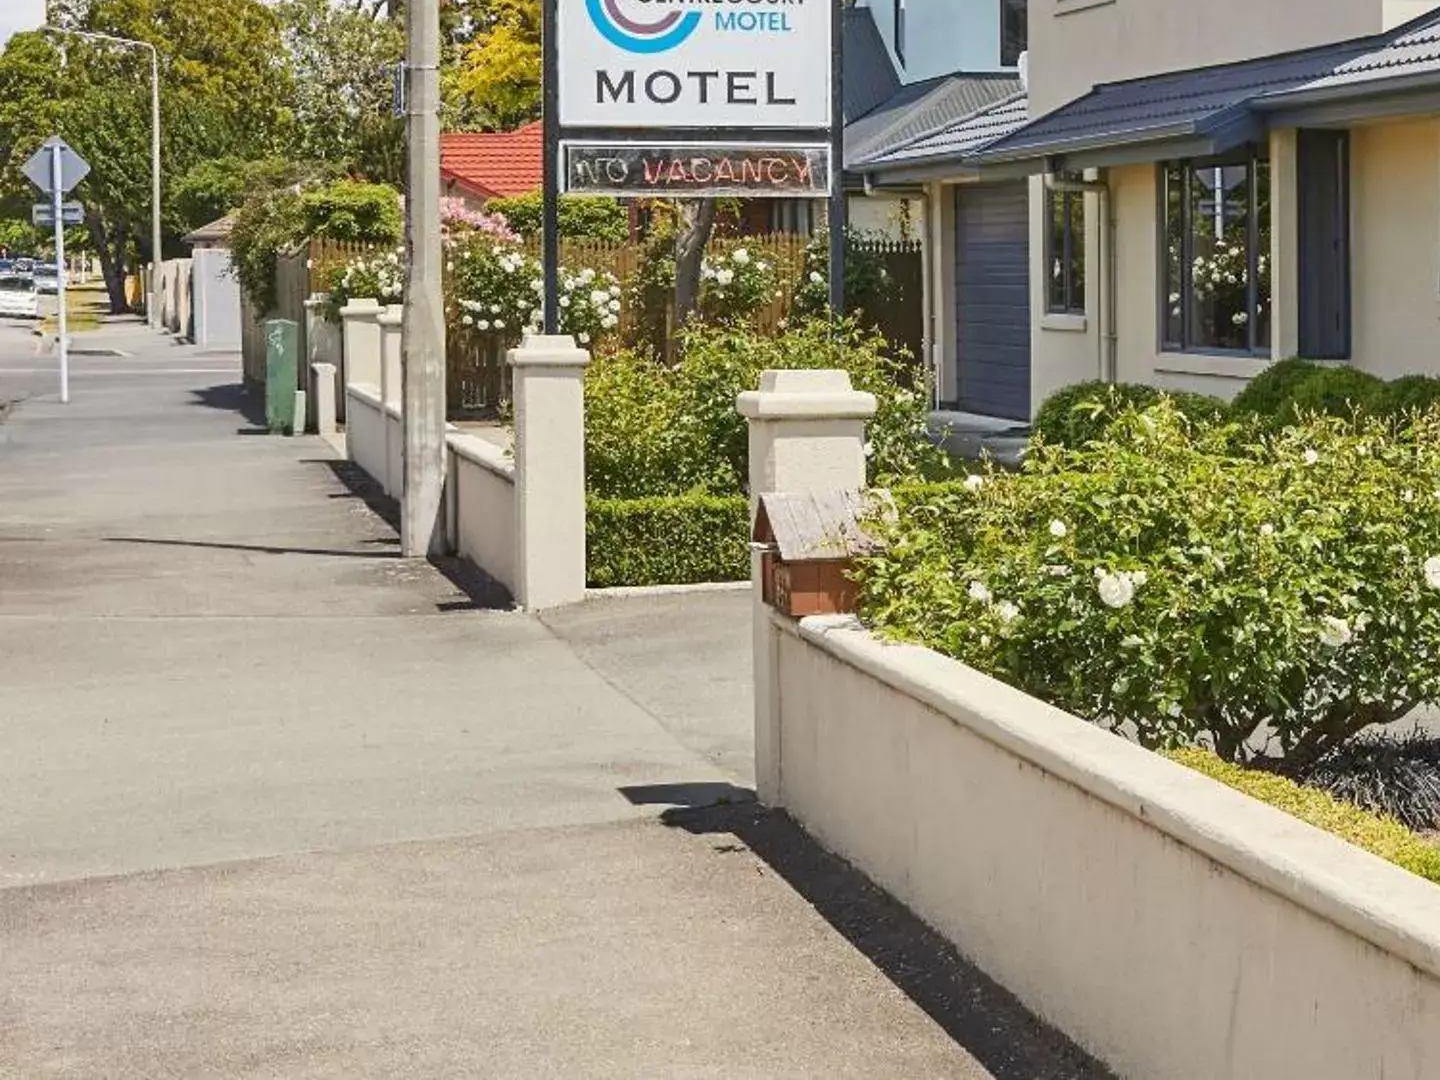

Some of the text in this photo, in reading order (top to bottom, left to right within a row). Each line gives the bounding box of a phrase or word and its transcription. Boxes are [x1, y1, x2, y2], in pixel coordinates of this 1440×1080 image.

[715, 11, 792, 32] MOTEL
[596, 69, 796, 105] MOTEL
[576, 157, 814, 187] NO VACANCY
